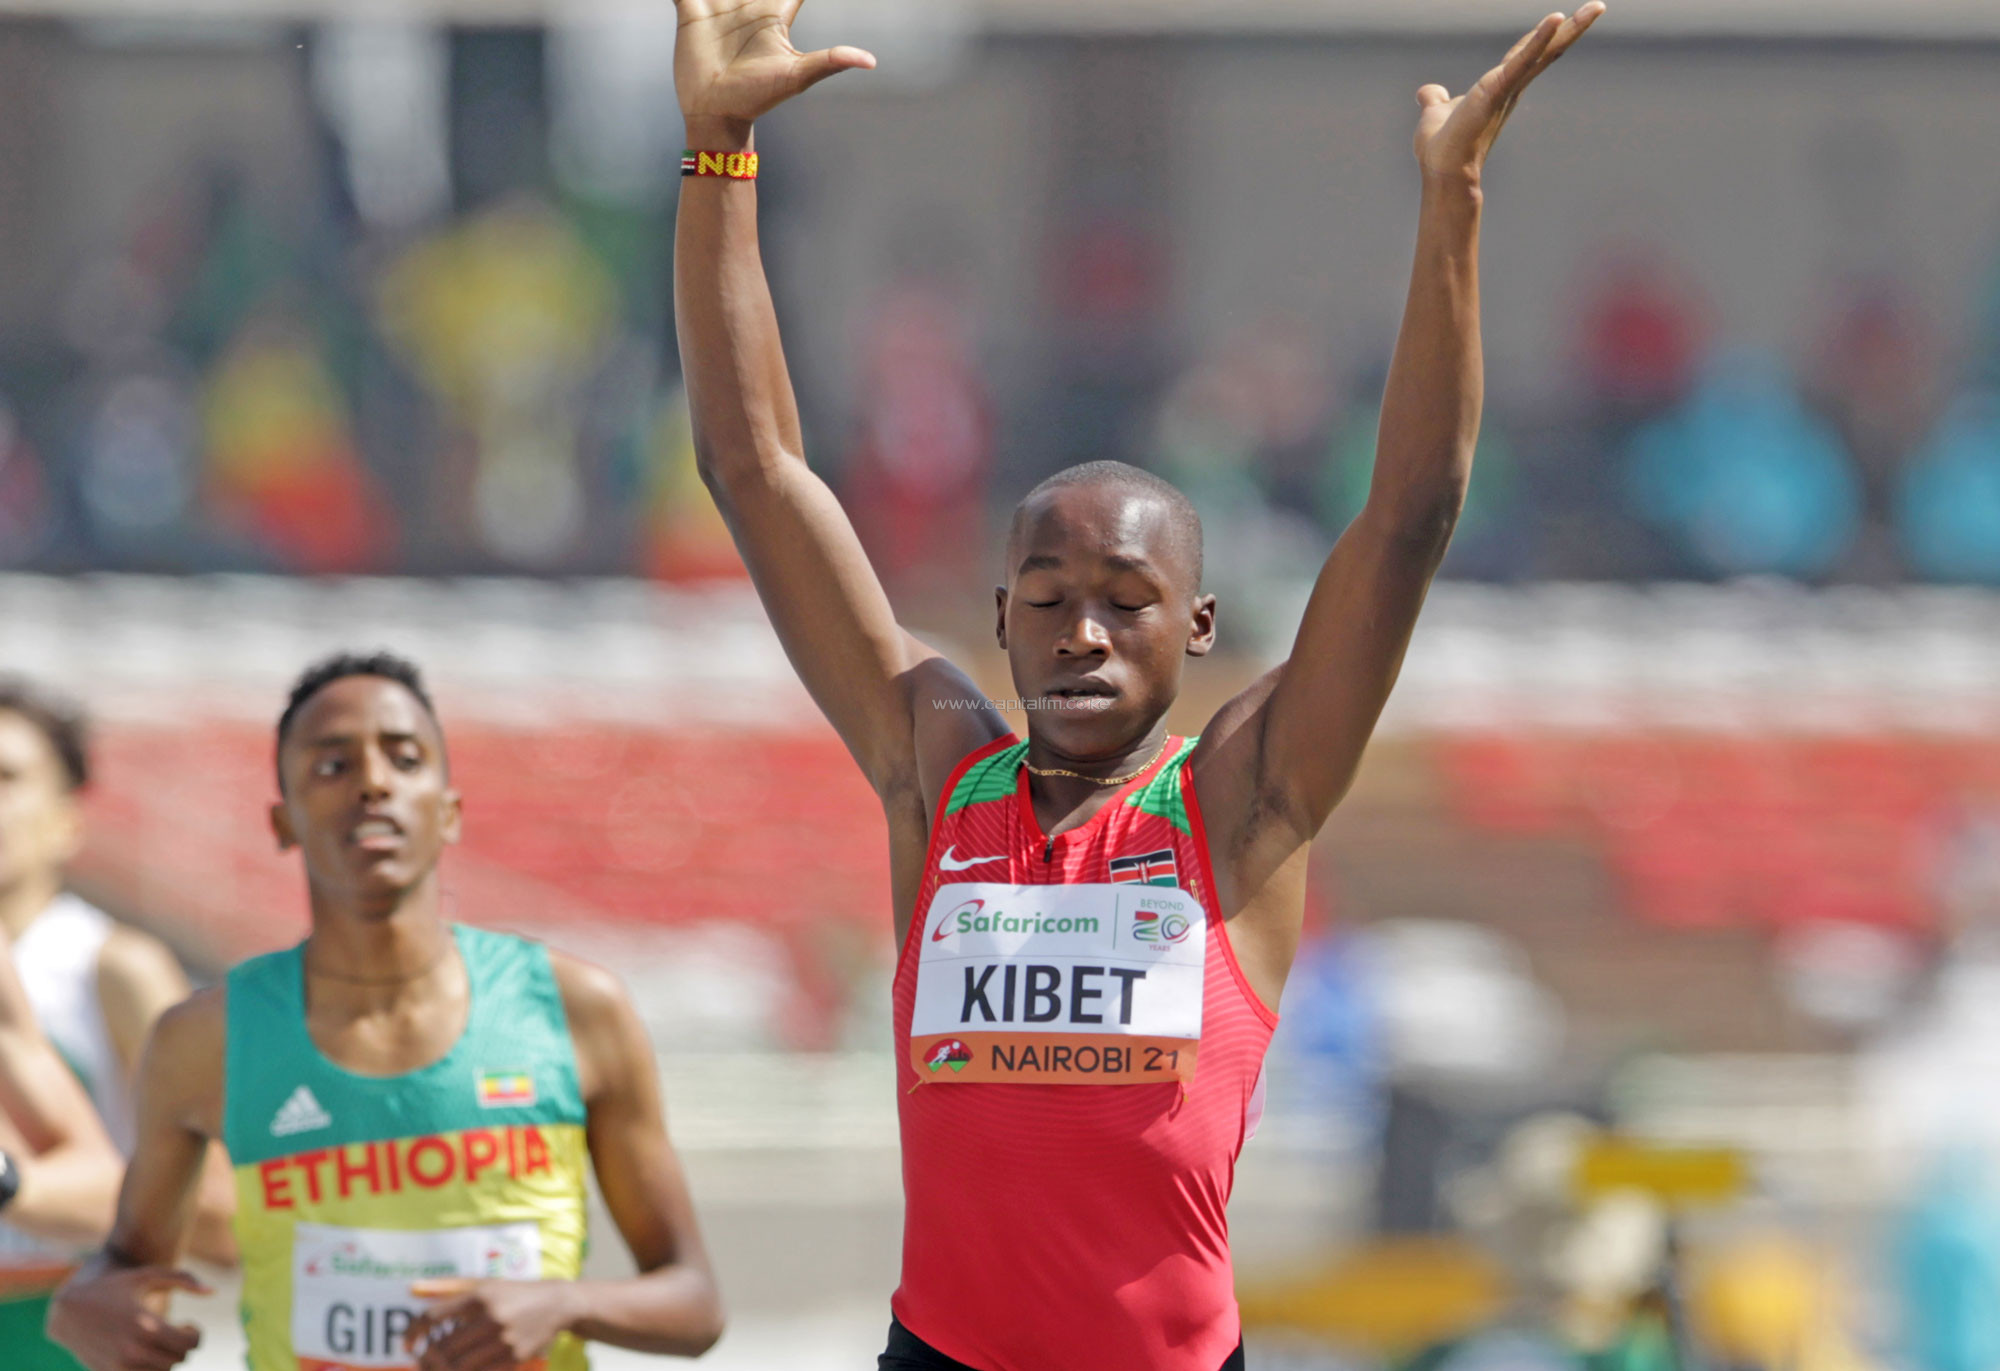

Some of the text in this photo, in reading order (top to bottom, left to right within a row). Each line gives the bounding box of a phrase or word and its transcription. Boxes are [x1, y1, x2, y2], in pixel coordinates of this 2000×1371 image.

[1140, 898, 1184, 911] BEYOND
[956, 910, 1099, 934] Safaricom
[1149, 944, 1171, 952] YEARS
[960, 964, 1147, 1025] KIBET
[991, 1044, 1178, 1073] NAIROBI 21
[258, 1124, 553, 1212] ETHIOPIA
